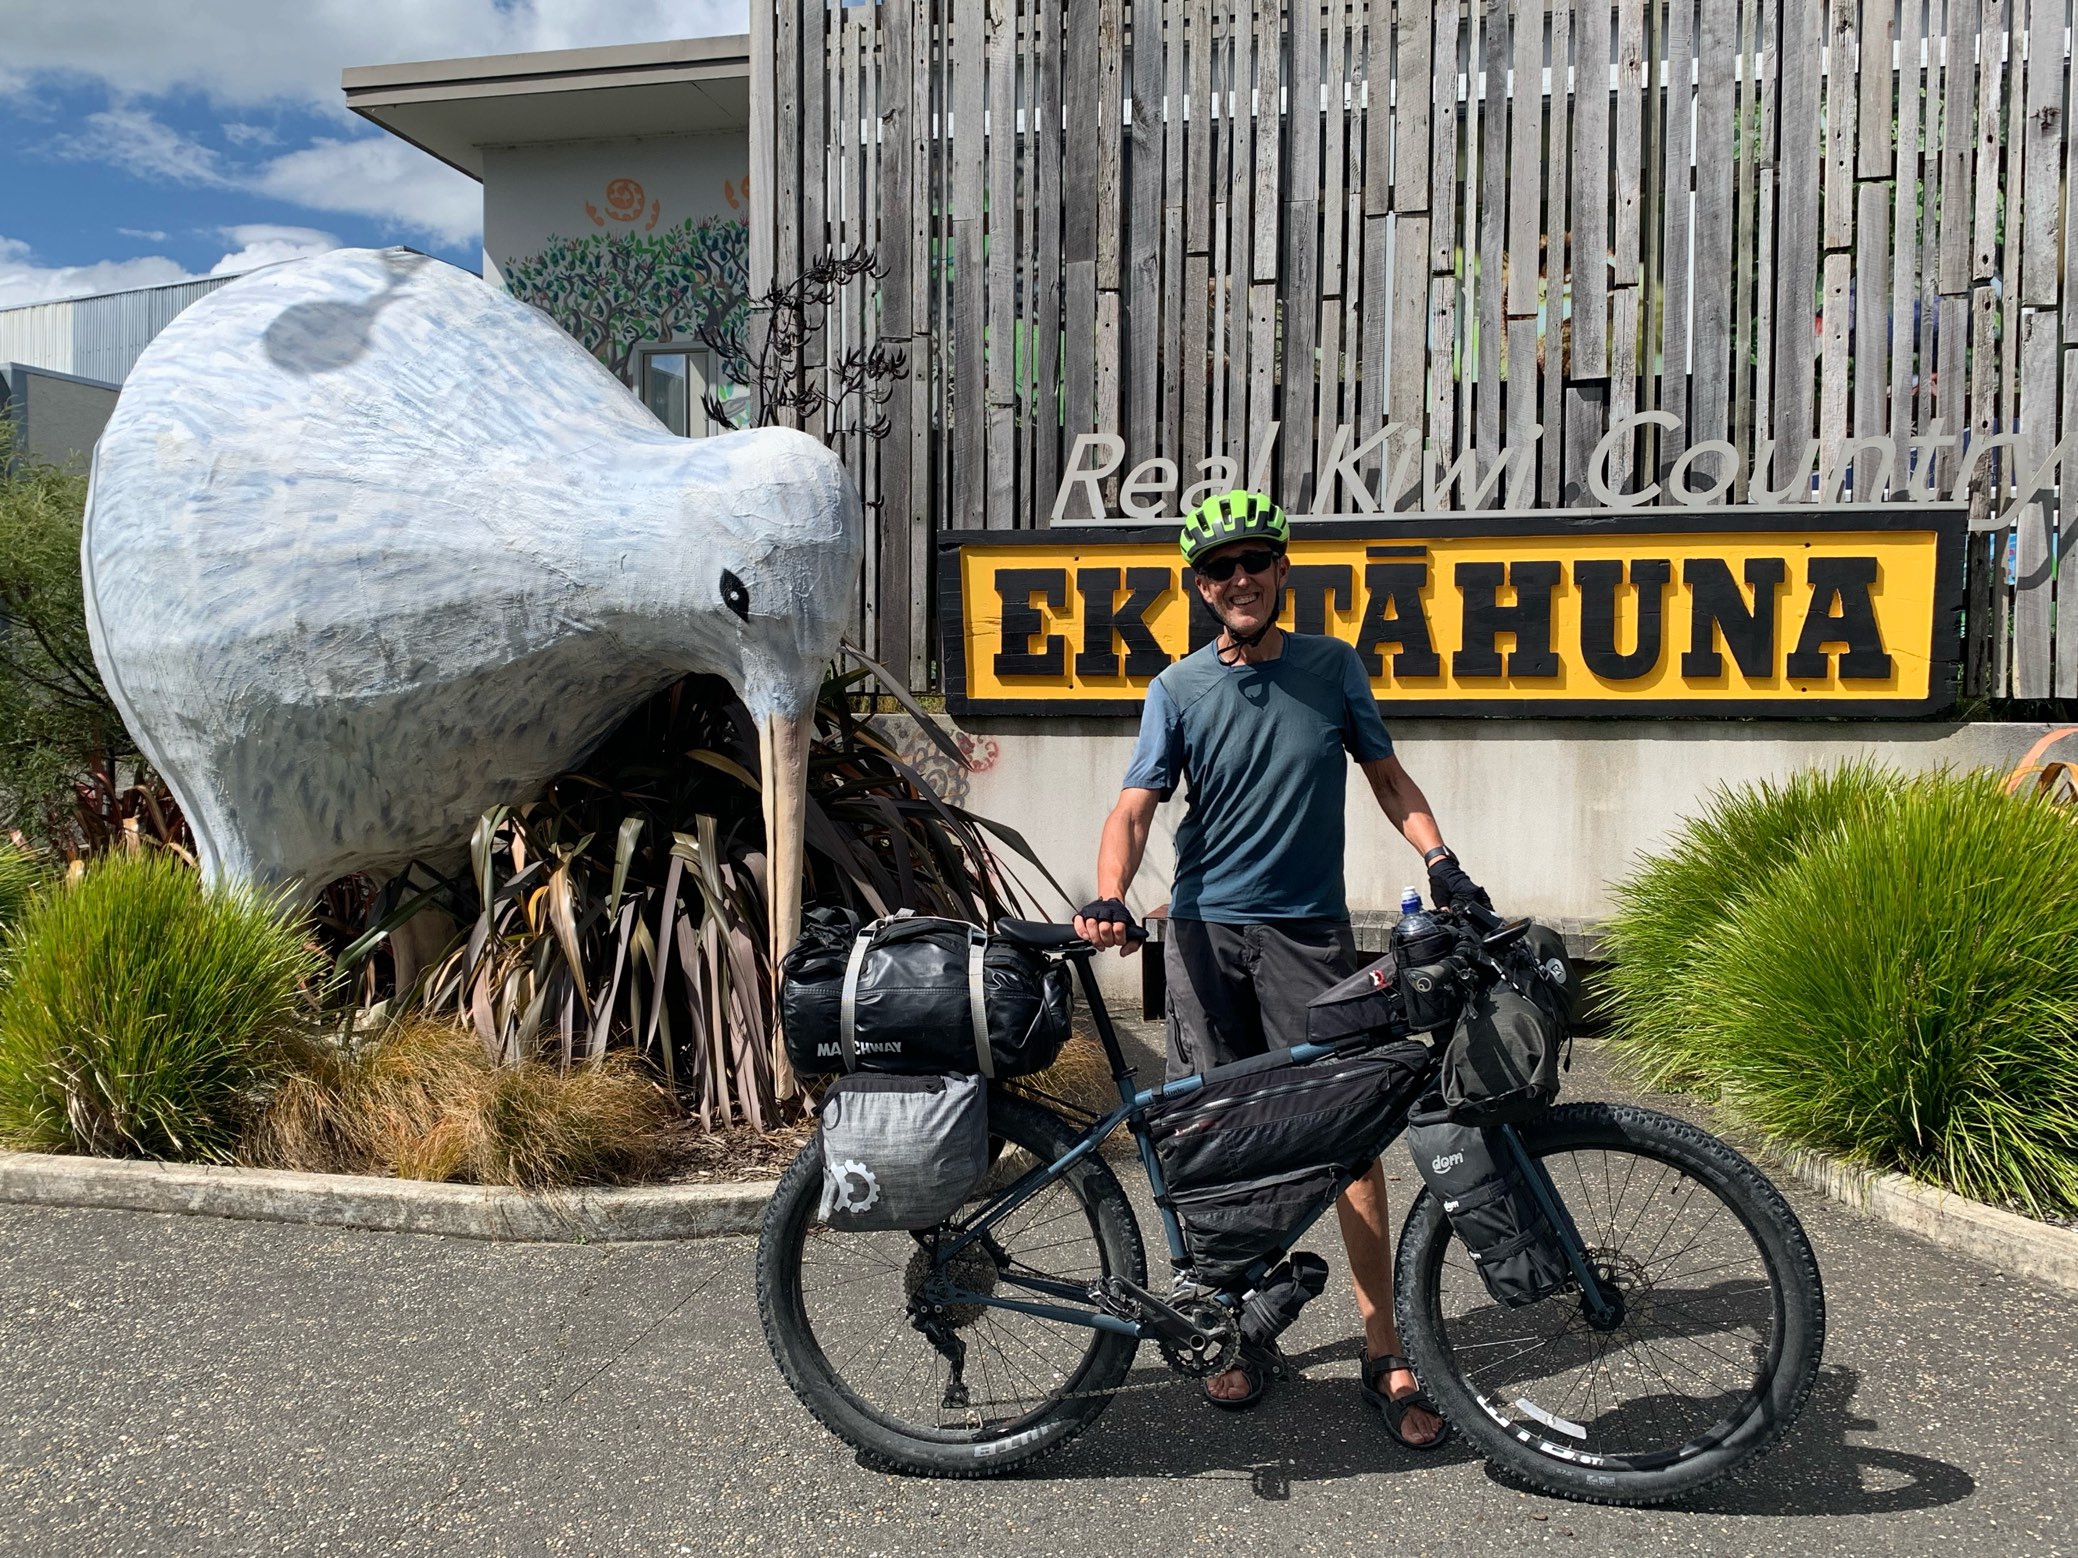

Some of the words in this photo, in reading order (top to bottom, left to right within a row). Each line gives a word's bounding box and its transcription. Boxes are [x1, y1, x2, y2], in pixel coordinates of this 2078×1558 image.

[1051, 420, 1281, 519] Real
[1310, 421, 1545, 515] Kiwi
[1587, 410, 2078, 531] Country
[817, 1040, 902, 1057] MACHWAY
[1432, 1151, 1464, 1174] dom
[1443, 1200, 1460, 1213] dom
